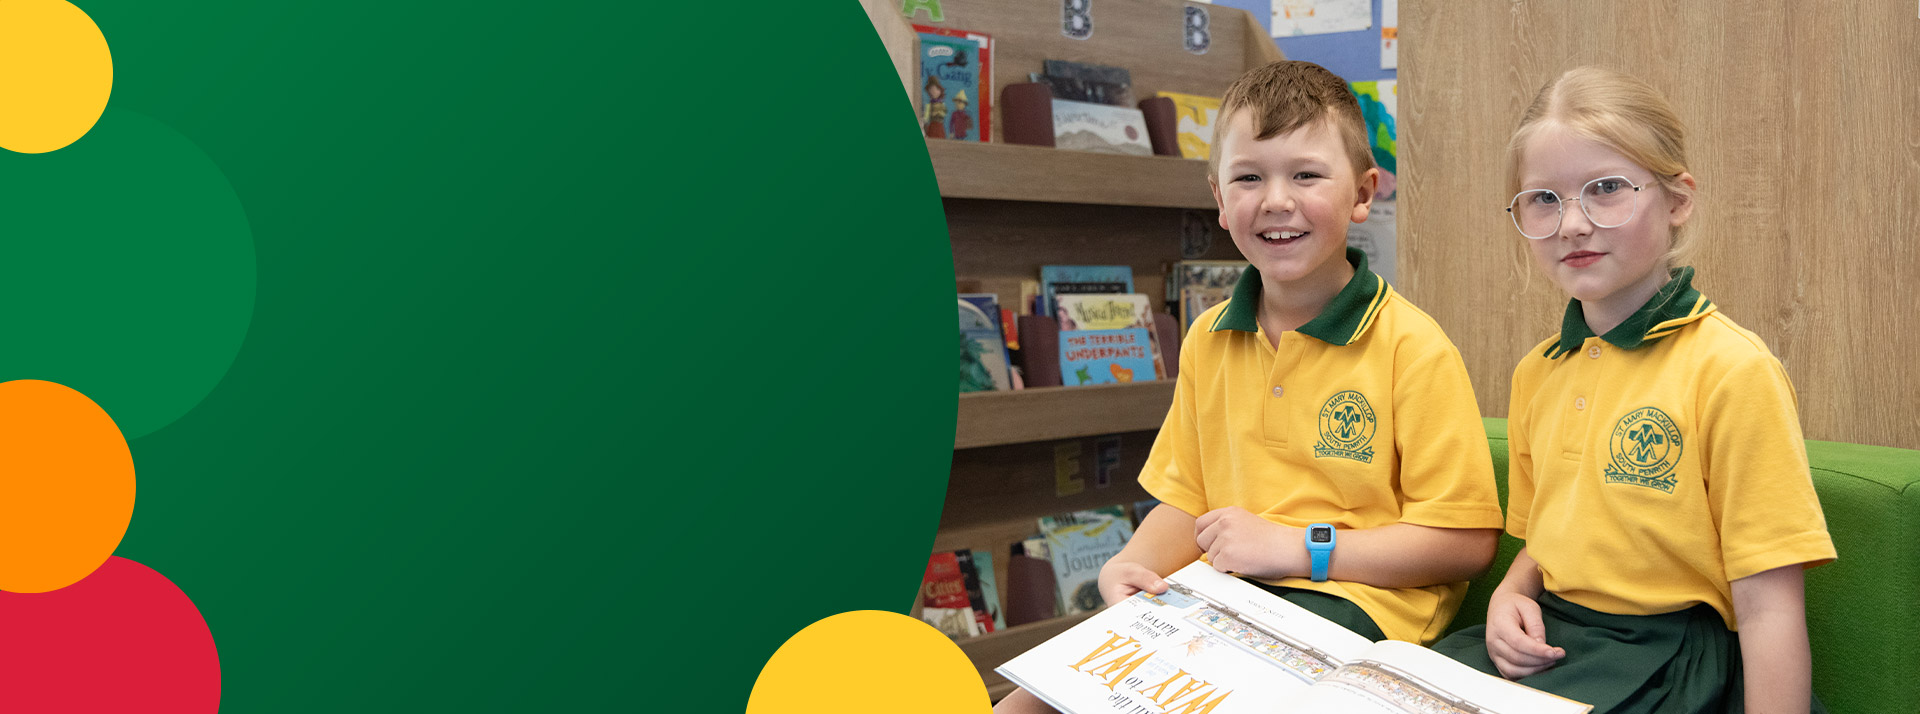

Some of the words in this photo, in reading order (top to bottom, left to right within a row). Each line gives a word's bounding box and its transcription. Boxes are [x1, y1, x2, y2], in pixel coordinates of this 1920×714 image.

[1183, 5, 1211, 54] B
[936, 63, 972, 87] Gang
[1067, 336, 1086, 346] THE
[1089, 334, 1135, 344] TERRIBLE
[1065, 346, 1145, 362] UNDERPANTS
[1322, 408, 1330, 418] ST
[1329, 393, 1345, 408] MARY
[1348, 393, 1374, 423] MACKILLOP
[1615, 425, 1624, 437] ST
[1623, 410, 1644, 426] MARY
[1646, 410, 1680, 447] MACKILLOP
[1324, 431, 1341, 447] SOUTH
[1344, 435, 1367, 450] PENRITH
[1616, 453, 1636, 473] SOUTH
[1639, 460, 1671, 476] PENRITH
[1129, 621, 1161, 639] Roland
[1137, 611, 1179, 637] Harvey
[1125, 676, 1144, 690] to
[1108, 691, 1133, 710] the
